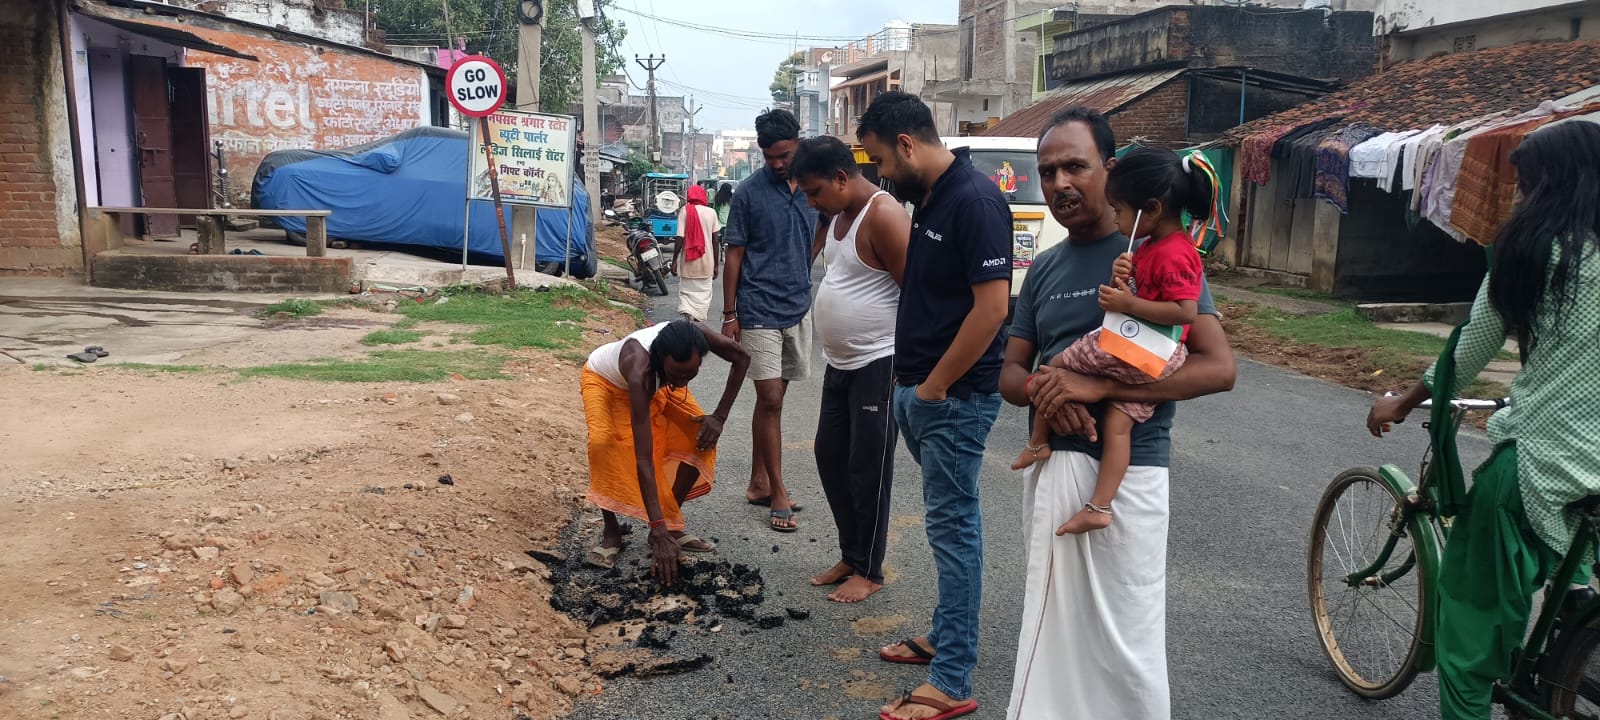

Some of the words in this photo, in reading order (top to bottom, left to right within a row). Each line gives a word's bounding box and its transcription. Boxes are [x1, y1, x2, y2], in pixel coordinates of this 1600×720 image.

[464, 68, 486, 83] GO
[457, 84, 498, 101] SLOW
[206, 74, 317, 130] irtel
[511, 145, 542, 161] सिलाई
[982, 258, 1000, 268] AMD
